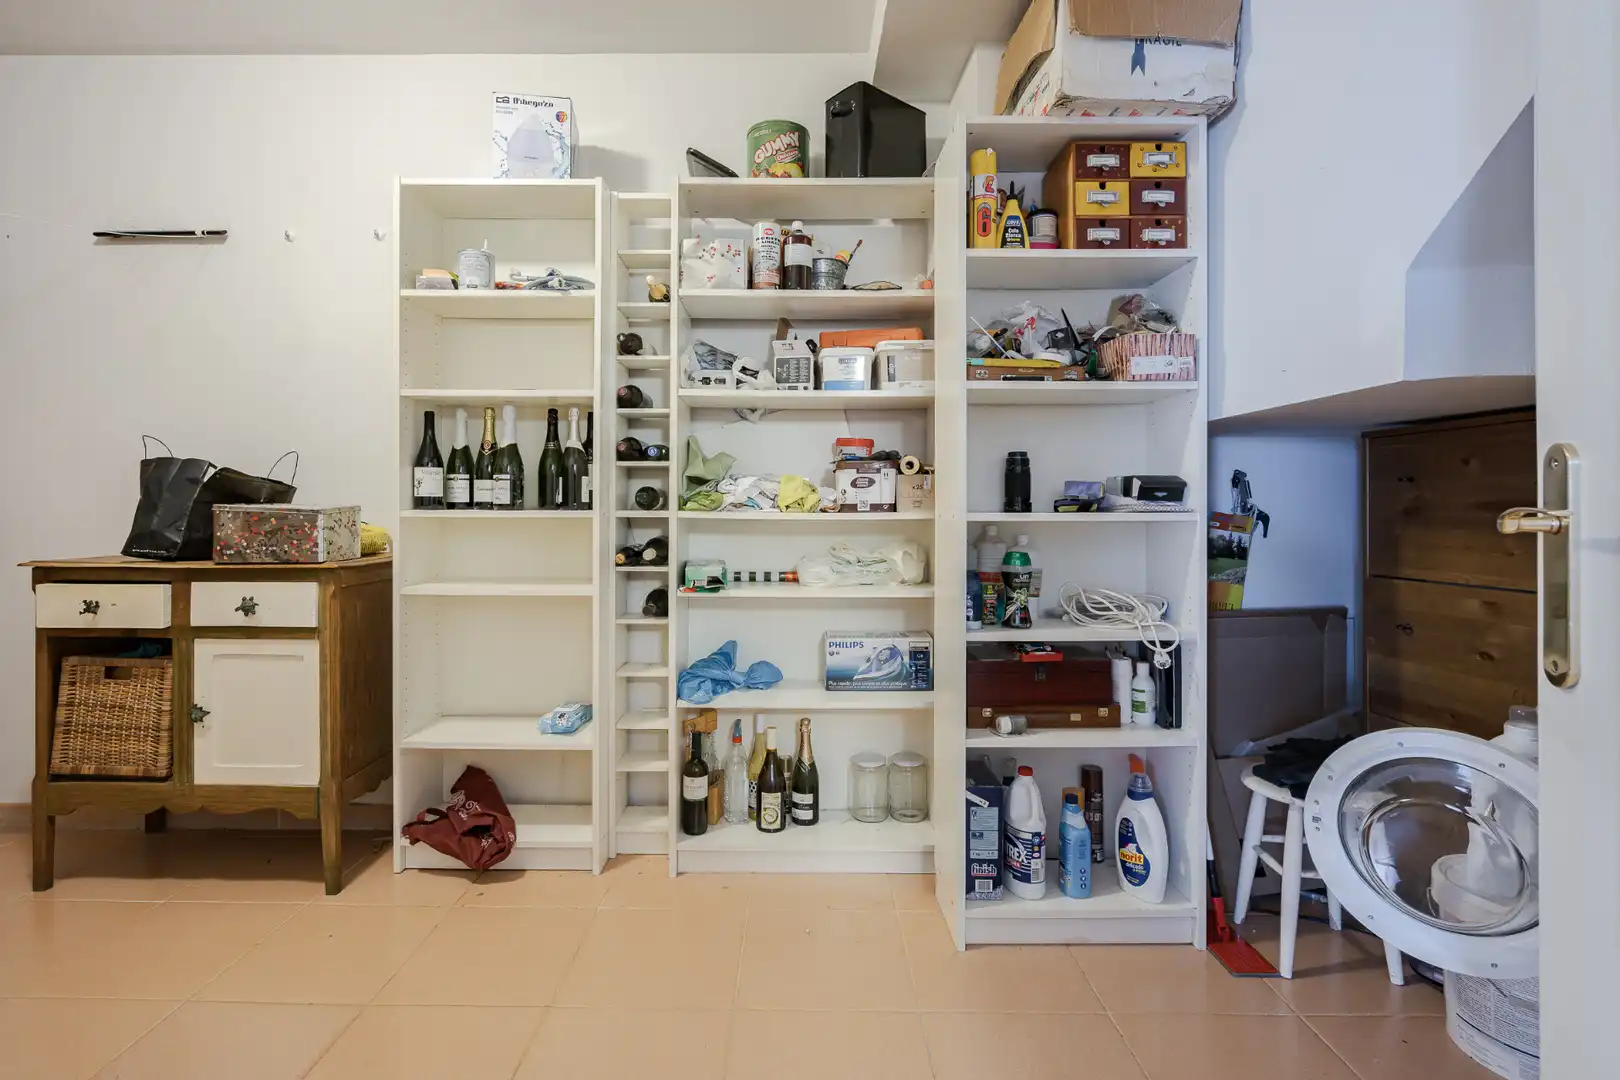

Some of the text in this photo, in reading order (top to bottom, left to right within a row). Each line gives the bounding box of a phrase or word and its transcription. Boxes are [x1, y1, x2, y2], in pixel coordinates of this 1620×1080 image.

[754, 131, 800, 164] GUMMY
[977, 206, 991, 237] 6
[828, 641, 865, 649] PHILIPS
[1120, 851, 1143, 863] norit
[971, 863, 998, 876] finish
